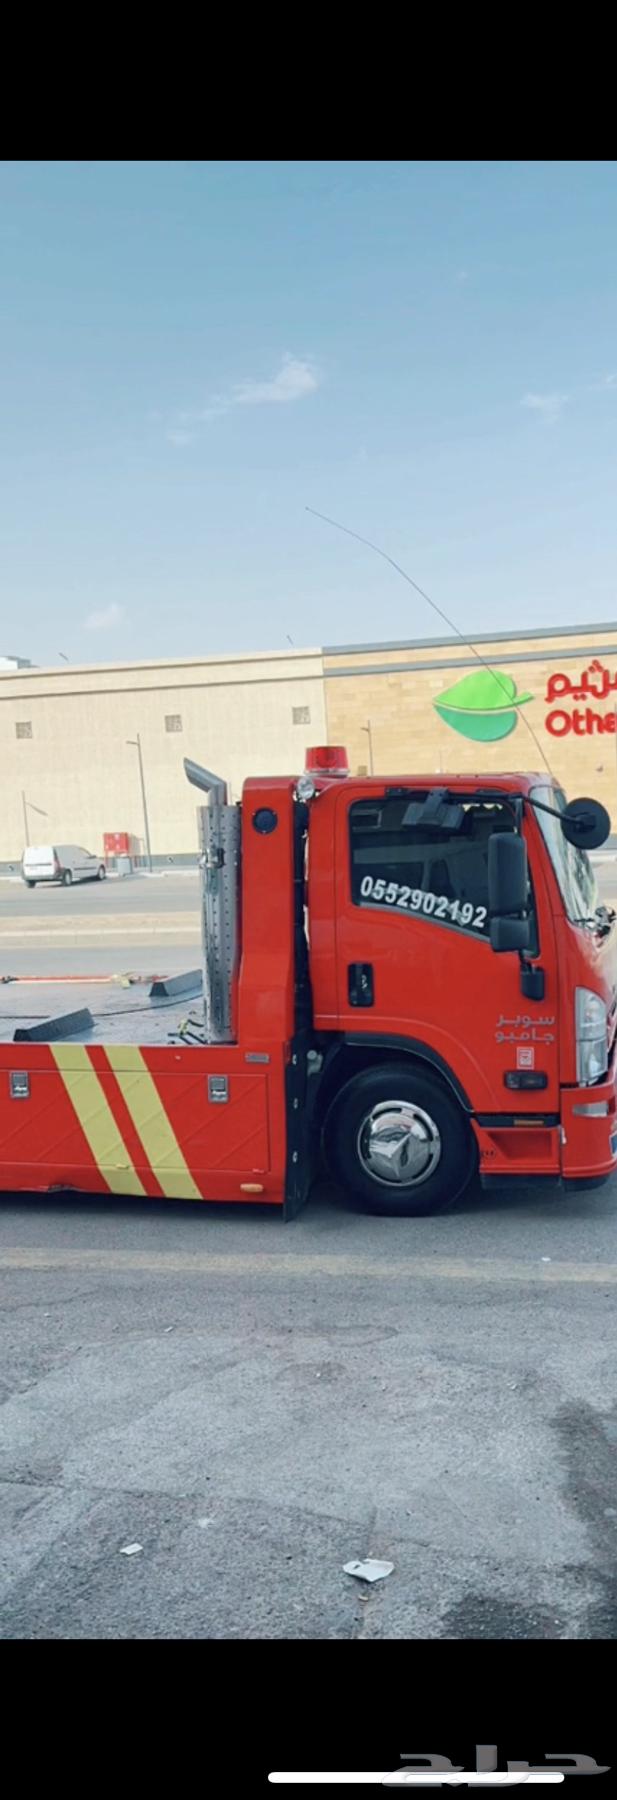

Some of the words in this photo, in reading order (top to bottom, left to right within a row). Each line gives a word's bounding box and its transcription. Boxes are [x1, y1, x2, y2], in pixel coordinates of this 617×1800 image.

[360, 876, 487, 928] 0552902192
[496, 1014, 555, 1028] سوبر
[495, 1028, 555, 1045] جامبو
